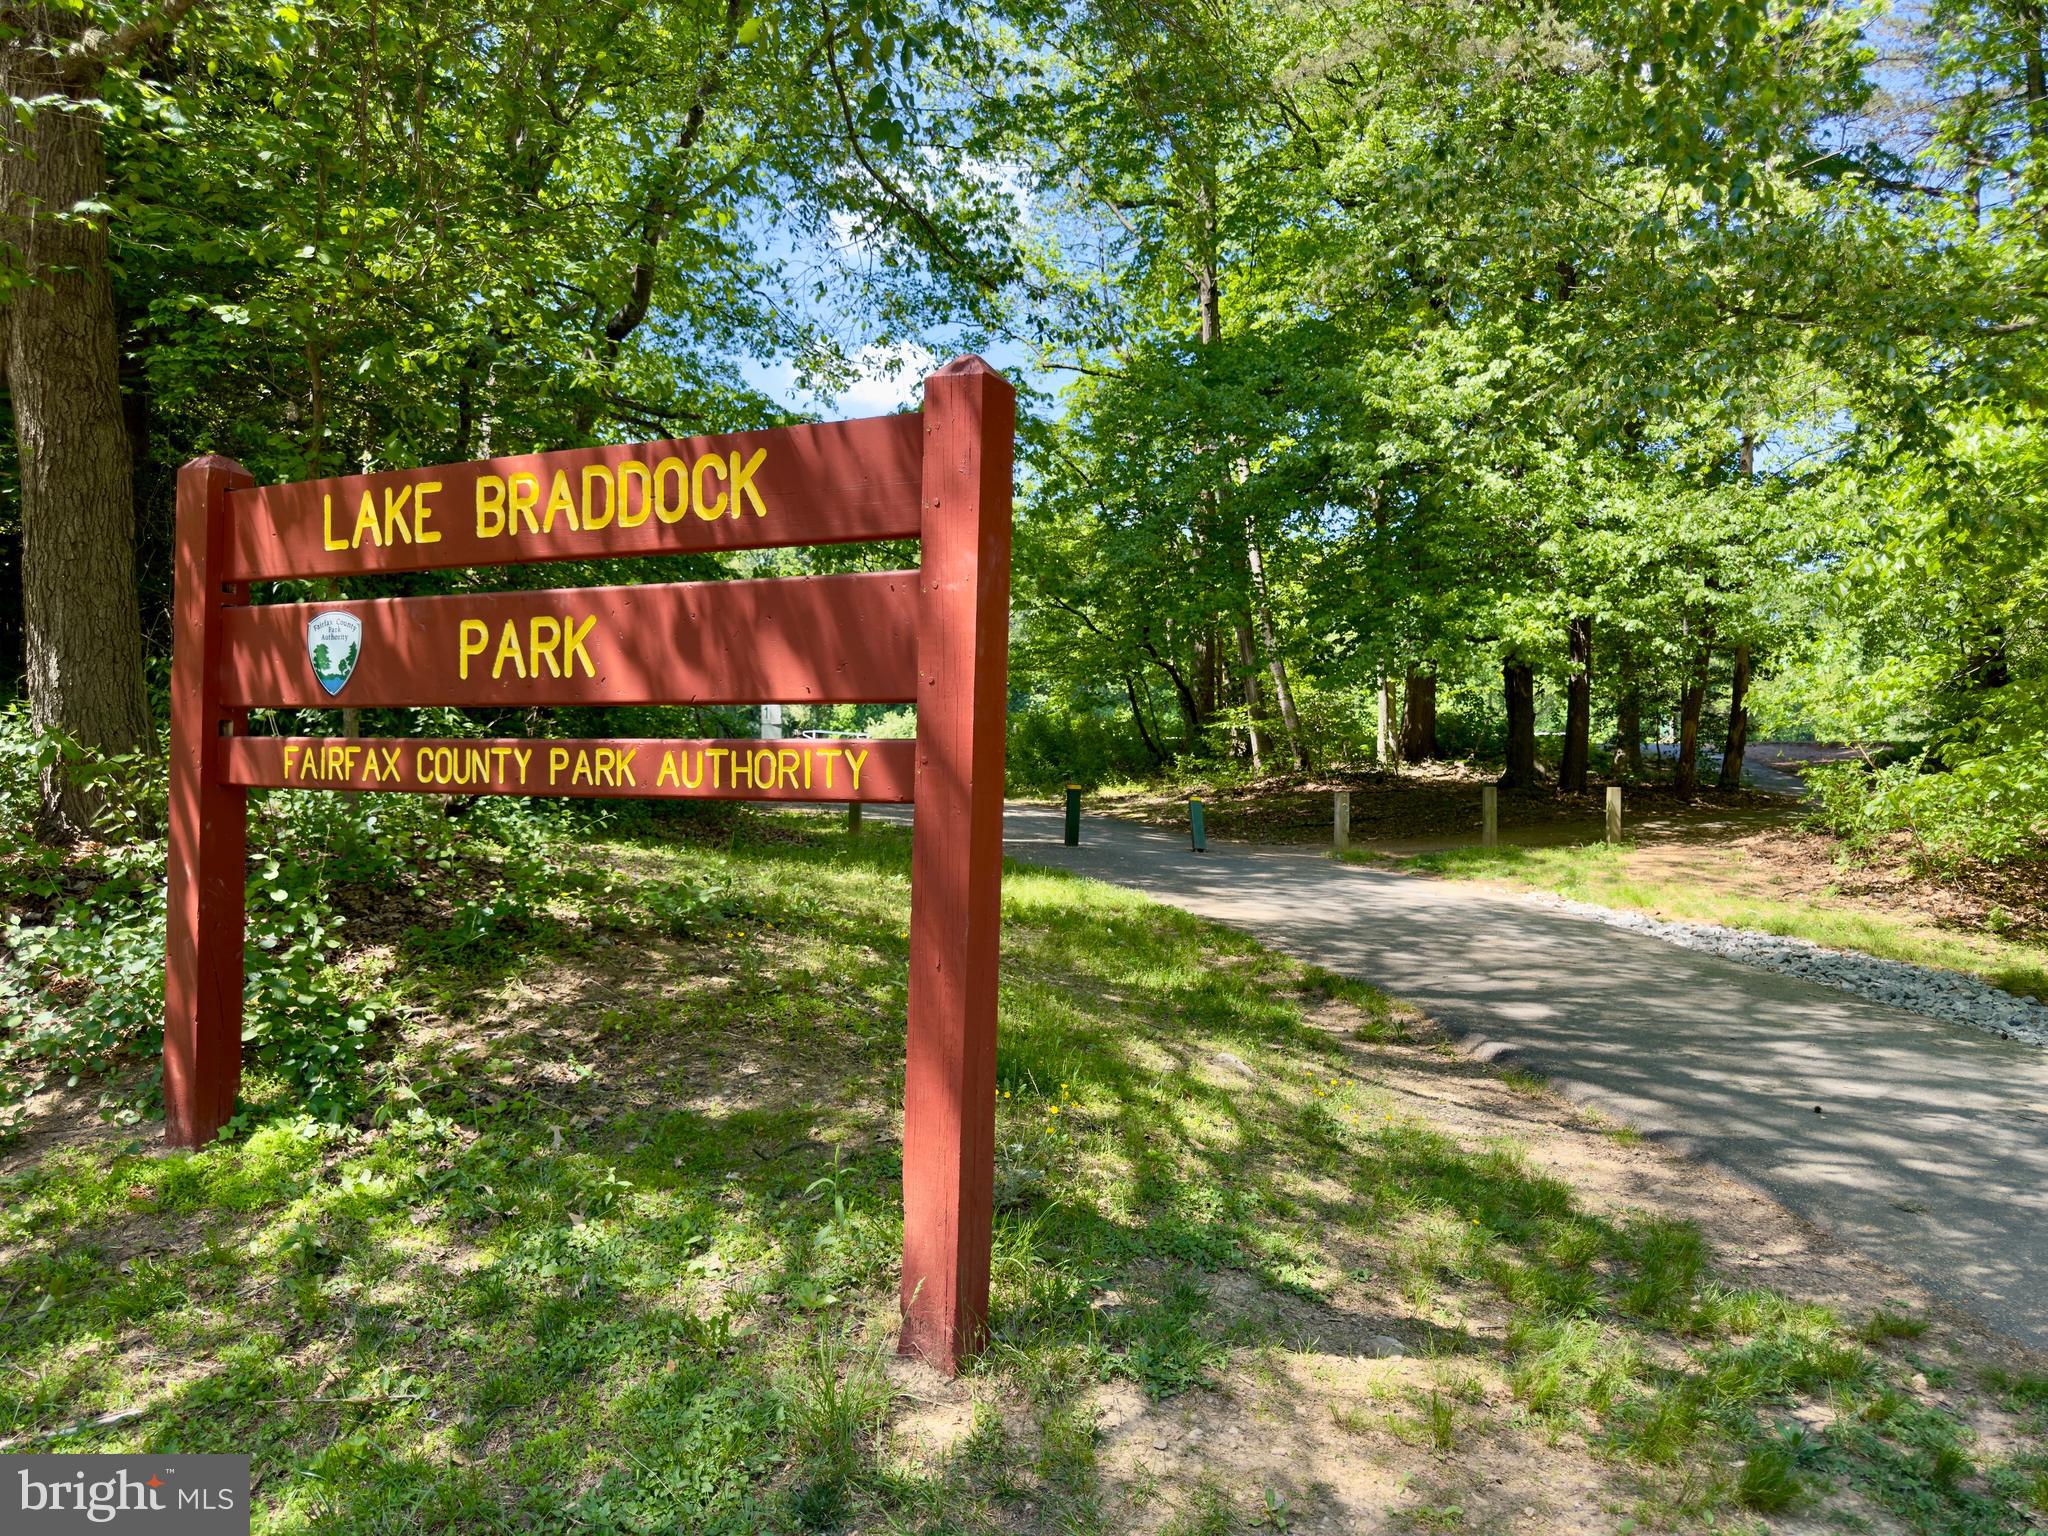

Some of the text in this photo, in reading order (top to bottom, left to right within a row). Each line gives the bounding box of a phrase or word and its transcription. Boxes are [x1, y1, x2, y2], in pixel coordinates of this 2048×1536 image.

[323, 448, 768, 551] LAKE BRADDOCK
[313, 618, 357, 632] Fairfax County
[321, 633, 348, 641] Authority
[458, 614, 597, 681] PARK
[283, 745, 869, 790] FAIRFAX COUNTY PARK AUTHORITY
